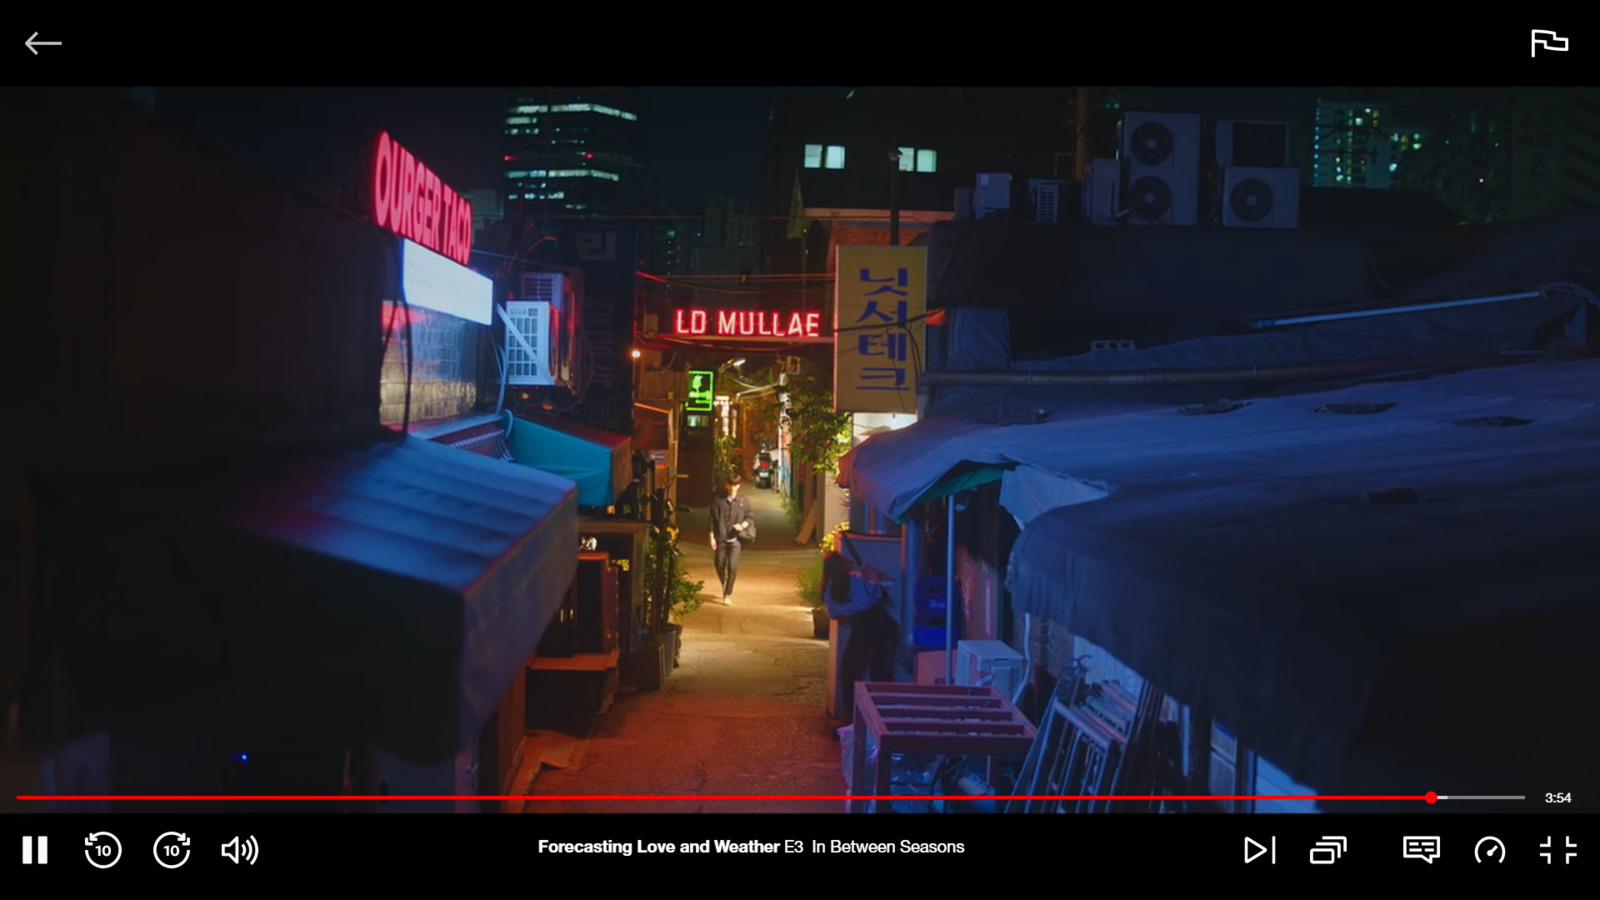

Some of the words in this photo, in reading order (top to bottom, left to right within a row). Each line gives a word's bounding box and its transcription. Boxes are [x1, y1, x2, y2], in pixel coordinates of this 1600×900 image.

[373, 130, 442, 252] OURGER
[442, 183, 473, 267] TACO
[716, 309, 821, 339] MULLAE
[855, 267, 911, 391] 닛서테크
